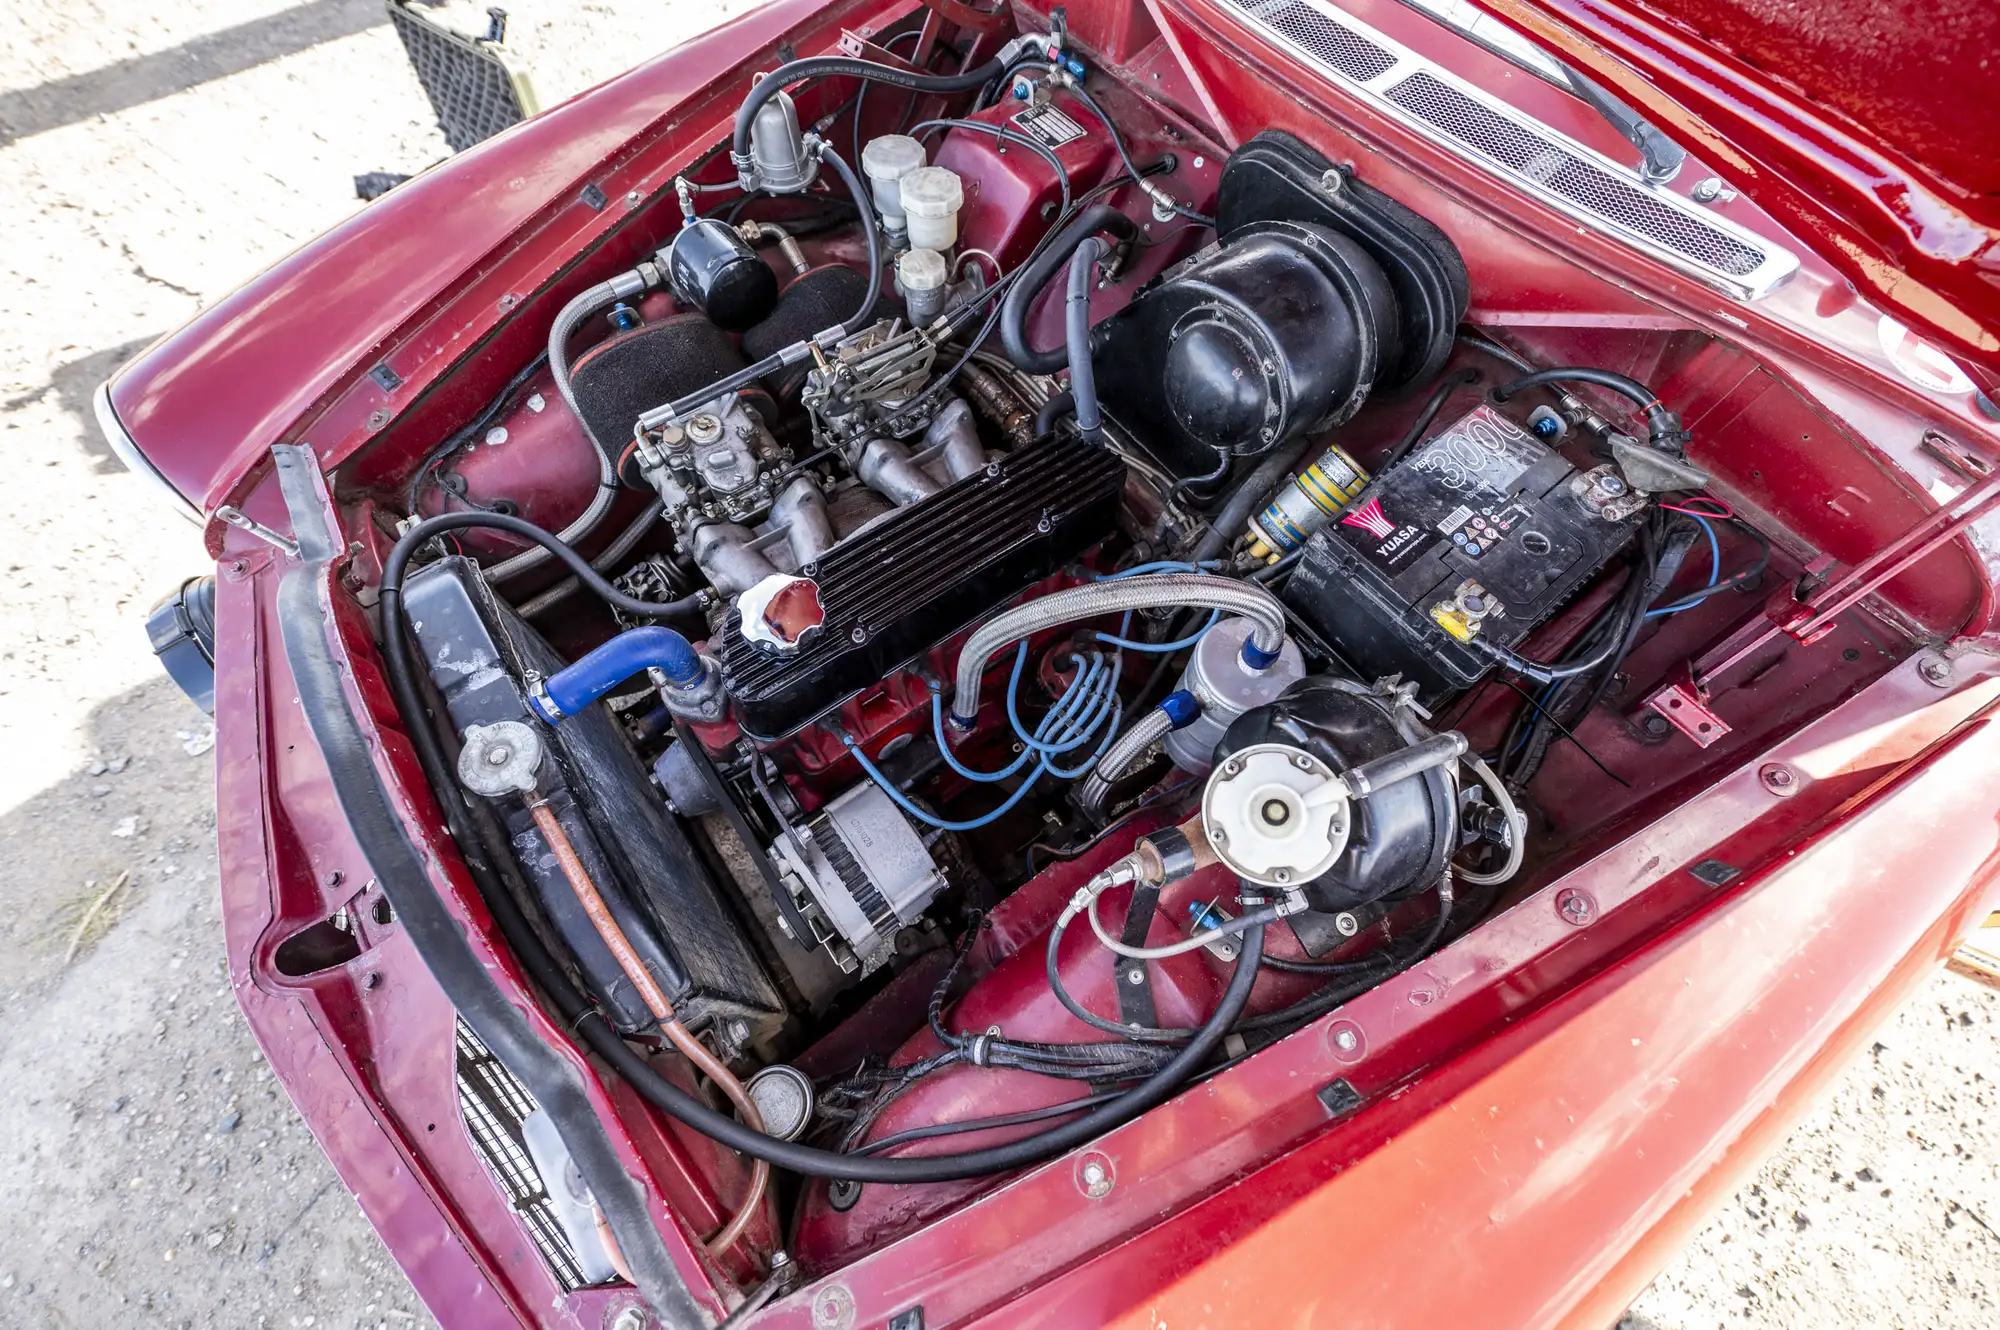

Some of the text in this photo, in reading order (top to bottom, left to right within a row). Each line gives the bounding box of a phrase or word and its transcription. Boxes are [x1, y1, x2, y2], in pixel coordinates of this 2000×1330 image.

[1410, 456, 1430, 472] YBX
[1267, 522, 1292, 546] Ignition
[1376, 525, 1419, 557] YUASA
